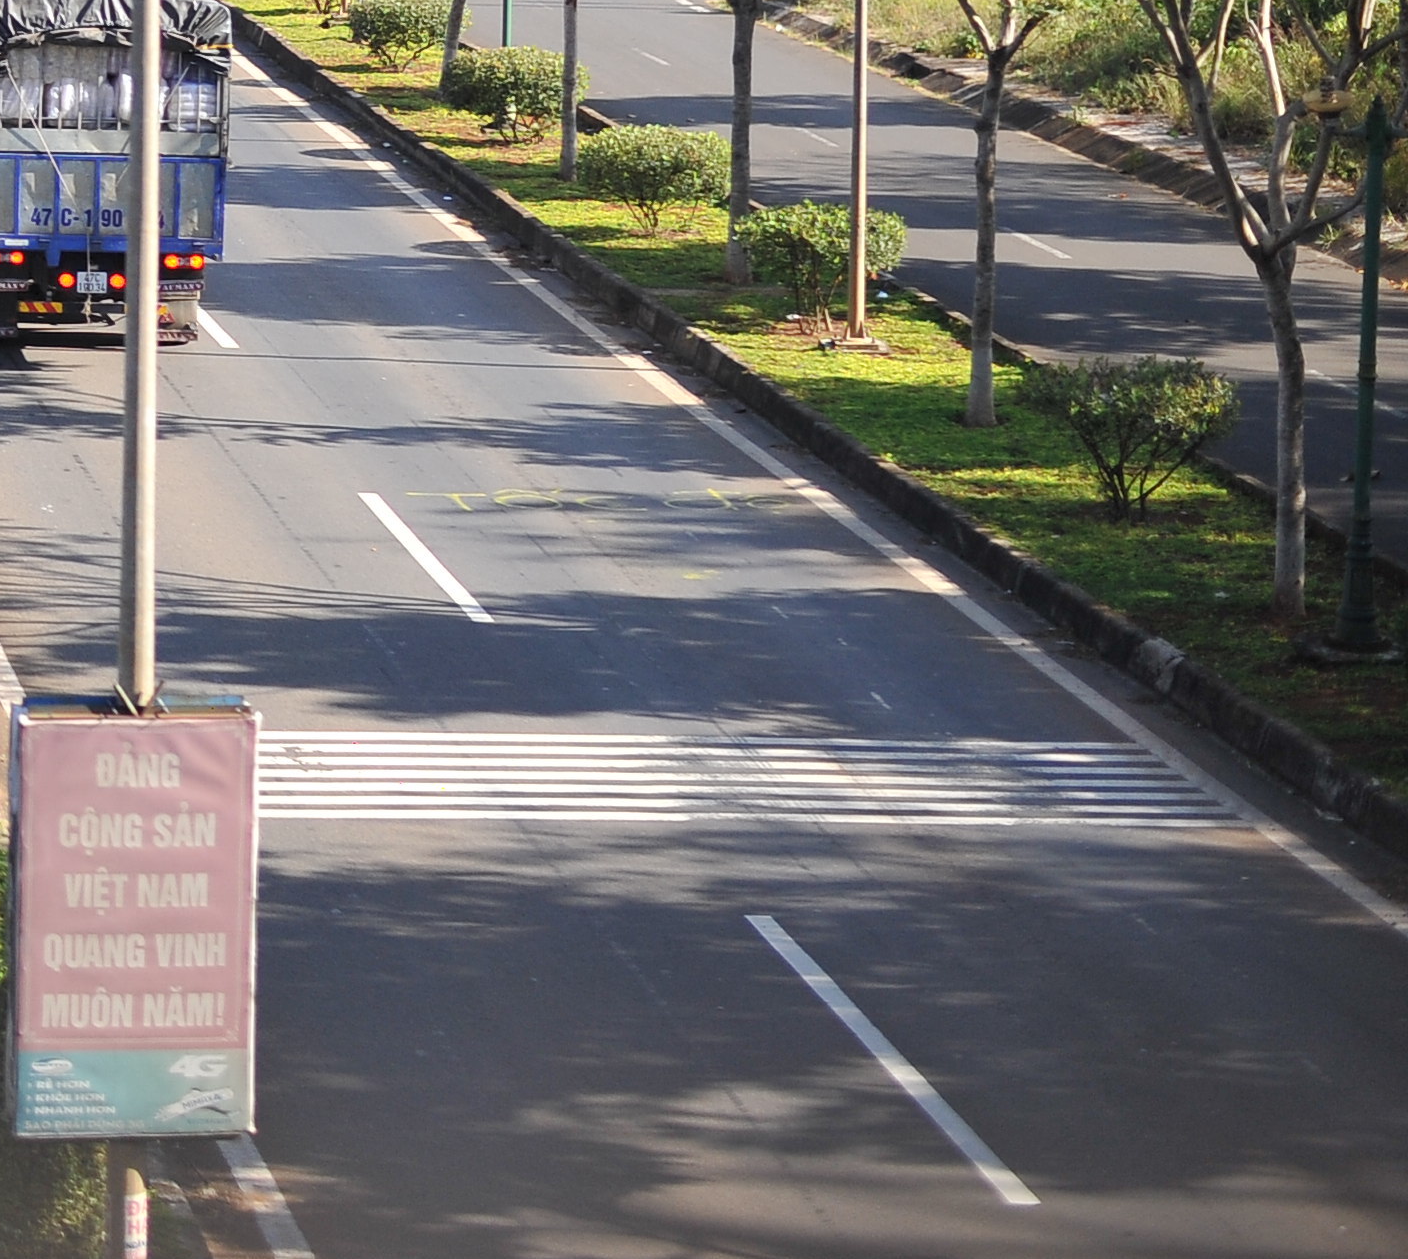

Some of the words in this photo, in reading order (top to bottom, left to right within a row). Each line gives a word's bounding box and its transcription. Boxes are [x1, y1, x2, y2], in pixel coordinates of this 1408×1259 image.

[95, 742, 180, 789] ĐẢNG
[59, 807, 143, 856] CỘNG
[153, 801, 215, 848] SẢN
[63, 867, 127, 915] VIỆT
[137, 871, 208, 908] NAM
[43, 933, 145, 972] QUANG
[154, 932, 226, 967] VINH
[42, 990, 133, 1029] MUÔN
[142, 986, 225, 1028] NĂM!
[168, 1054, 227, 1077] 4G
[34, 1105, 84, 1115] NHANH
